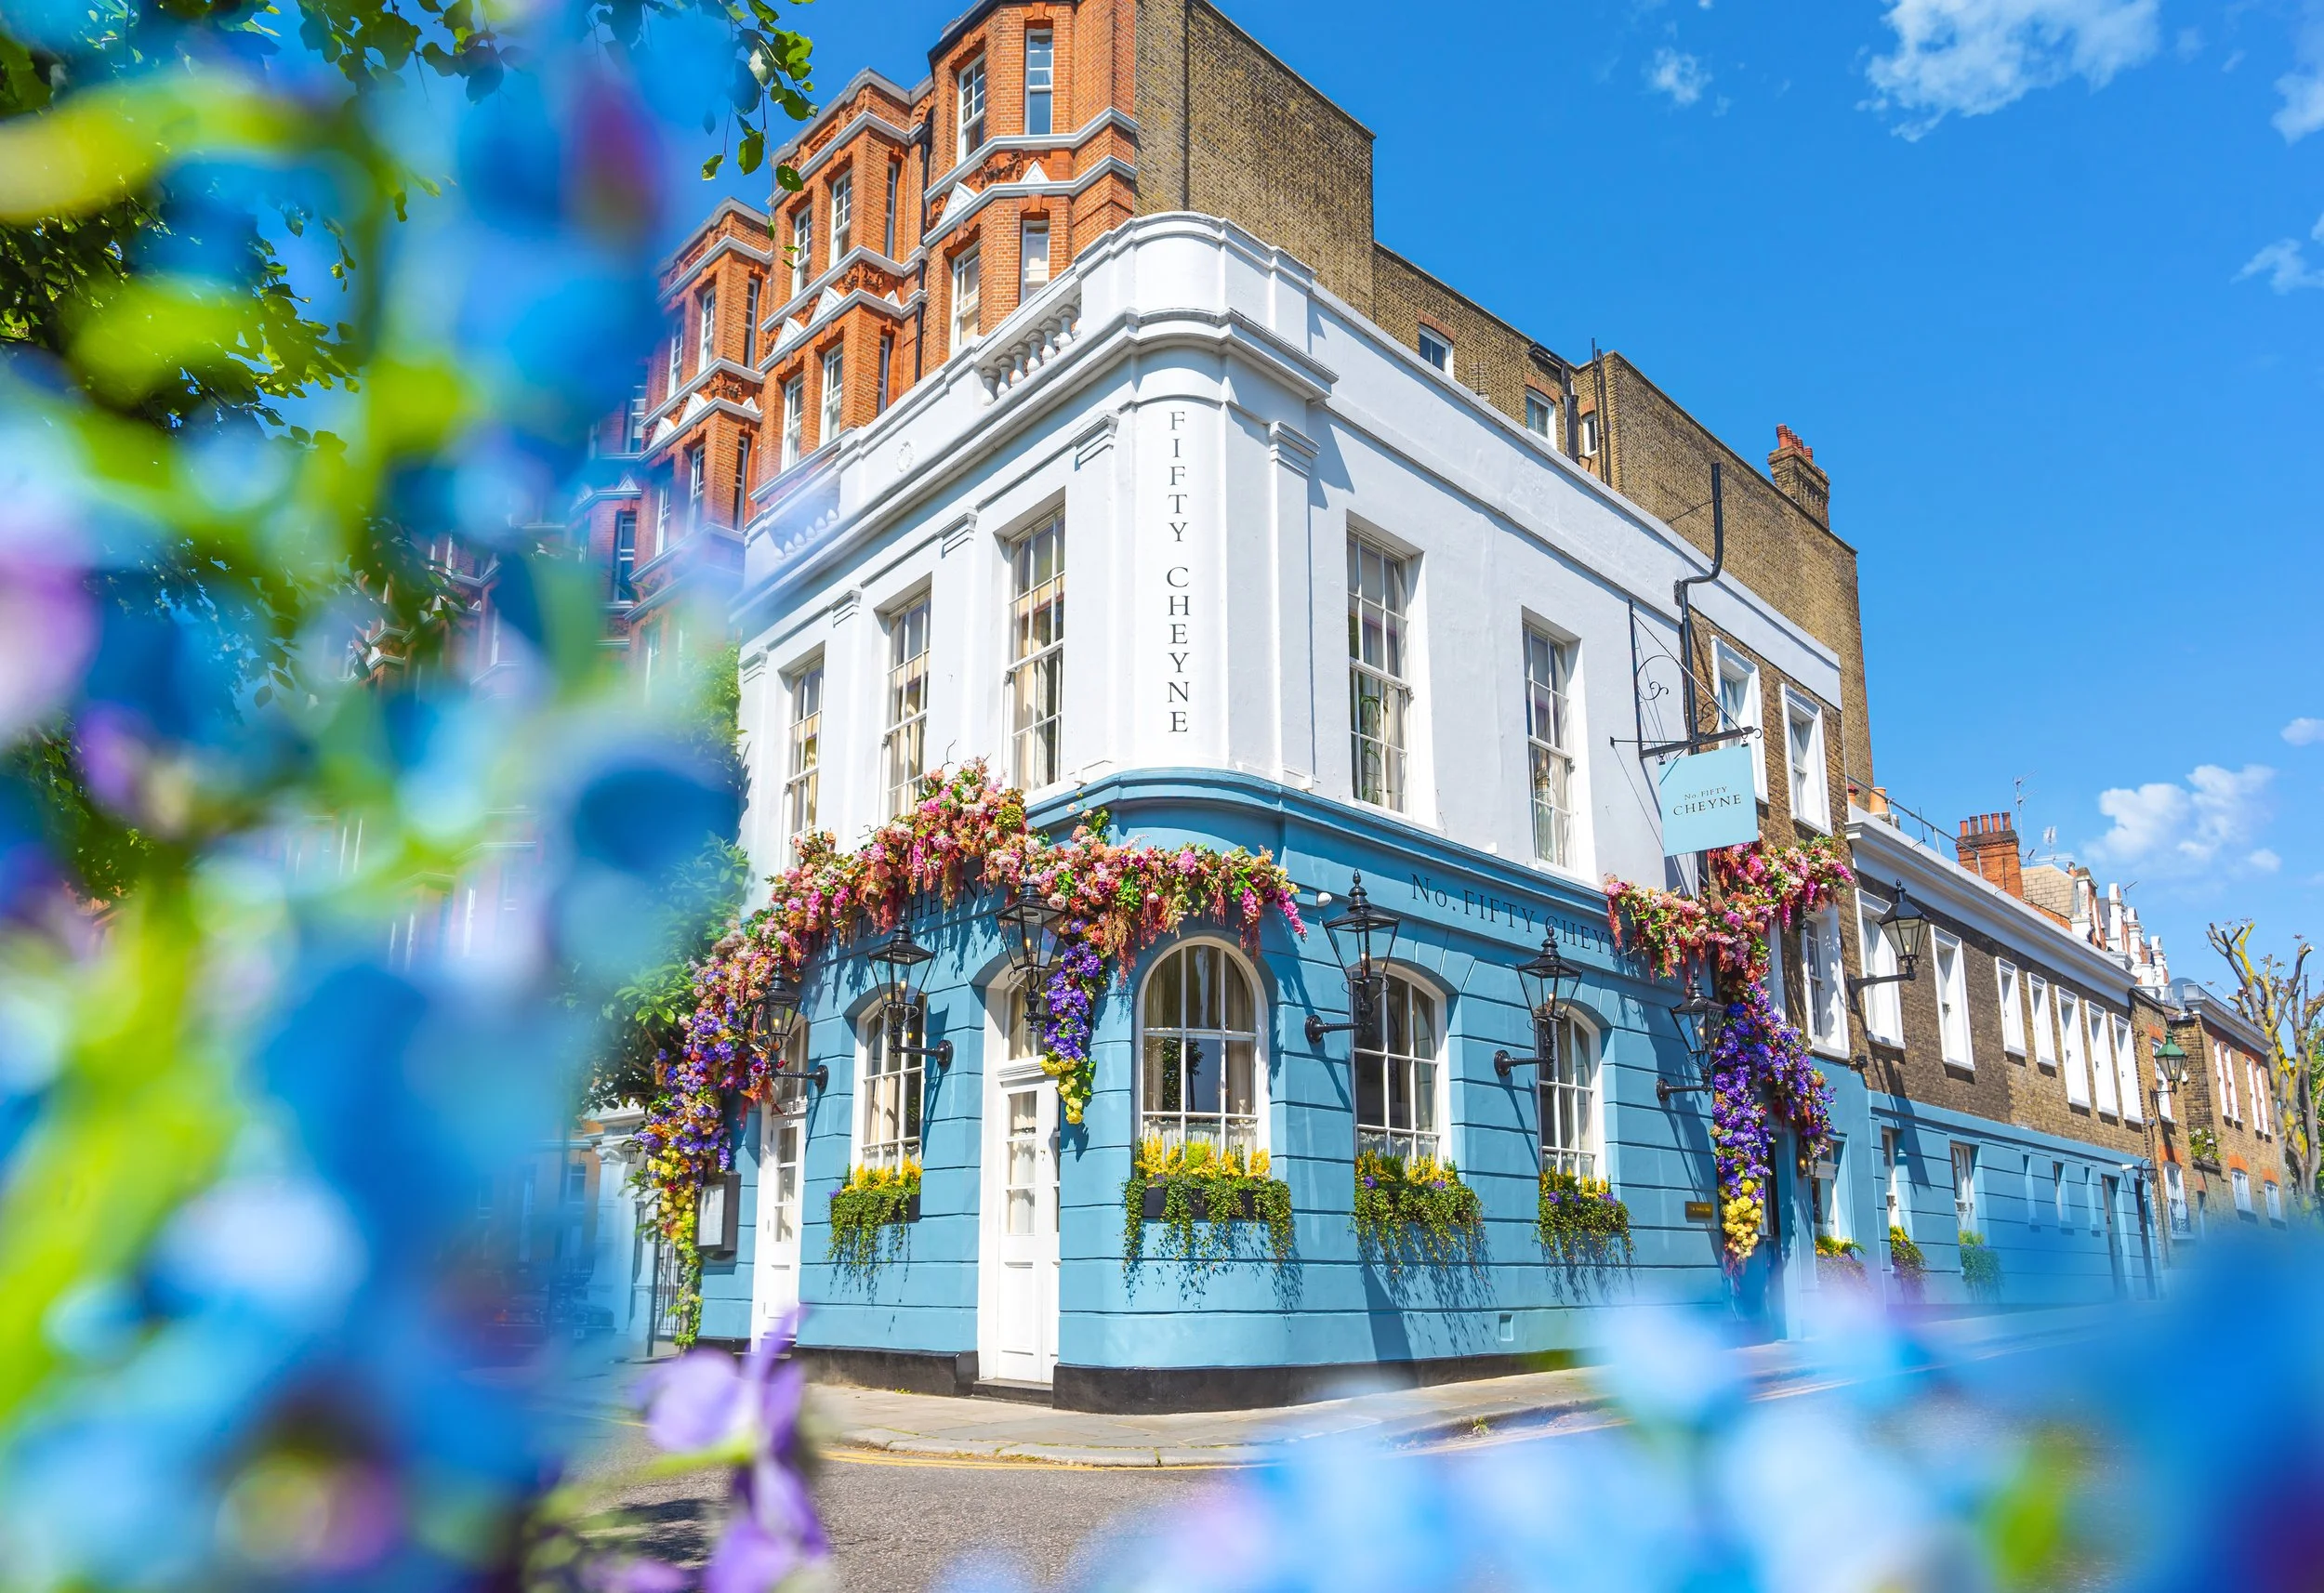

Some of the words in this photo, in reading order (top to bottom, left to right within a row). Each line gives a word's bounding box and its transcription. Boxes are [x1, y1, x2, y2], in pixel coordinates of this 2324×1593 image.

[1168, 411, 1188, 542] FIFTY
[1166, 566, 1191, 732] CHEYNE
[1673, 794, 1742, 816] CHEYNE
[1700, 786, 1727, 797] FIFTY
[1411, 873, 1457, 911] No.
[1463, 889, 1535, 933] FIFTY
